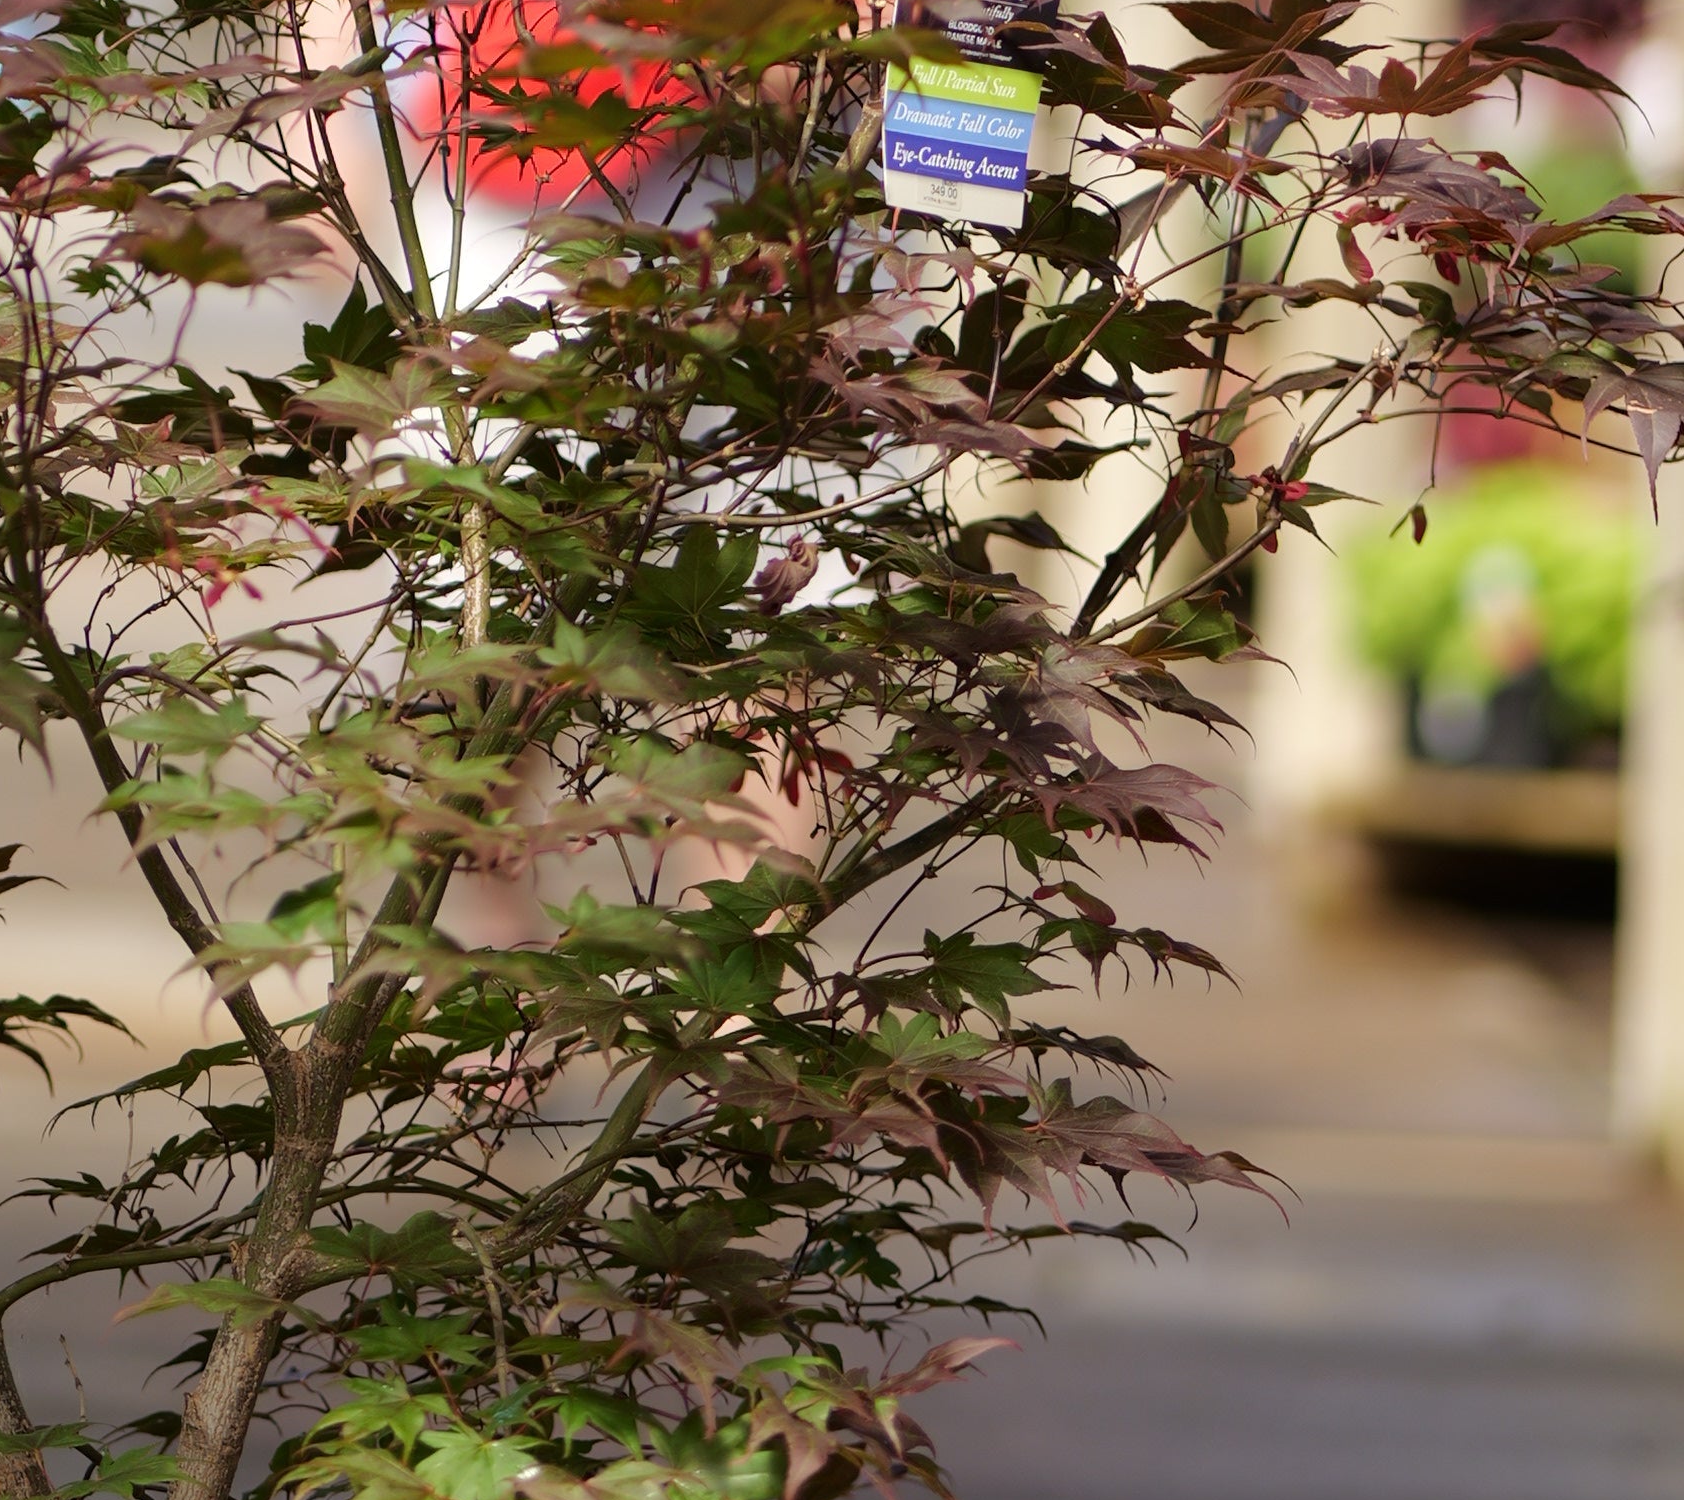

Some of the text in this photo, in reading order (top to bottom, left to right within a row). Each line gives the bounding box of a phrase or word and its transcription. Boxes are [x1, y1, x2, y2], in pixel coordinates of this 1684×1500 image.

[948, 19, 995, 36] BLOODGD
[912, 64, 938, 85] Full
[944, 70, 990, 95] Partial
[990, 77, 1017, 98] Sun
[893, 101, 1024, 139] Dramatic Fall Color
[892, 141, 1019, 180] Eye-Catching Accent
[930, 183, 958, 200] 349.00
